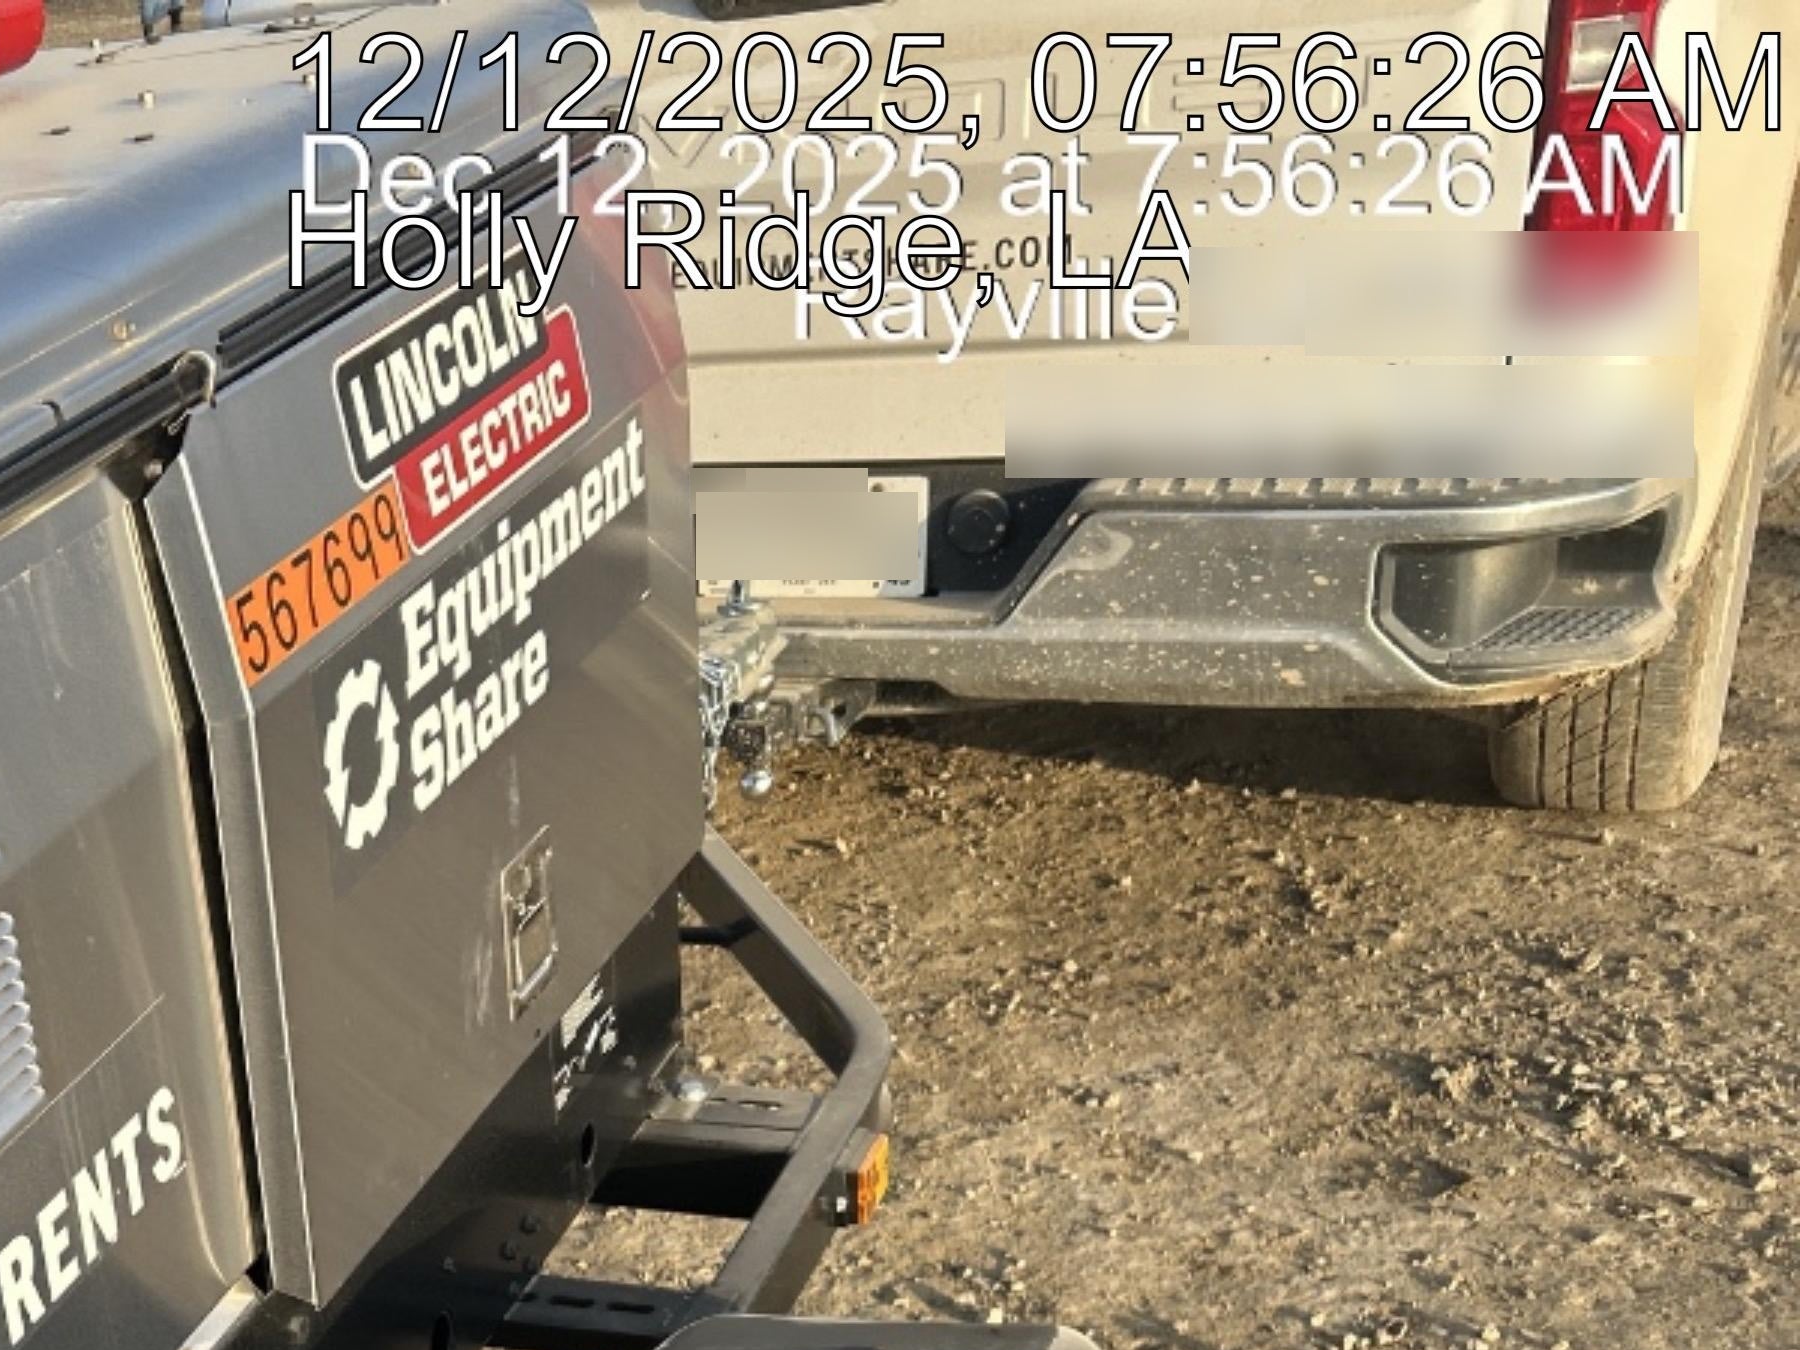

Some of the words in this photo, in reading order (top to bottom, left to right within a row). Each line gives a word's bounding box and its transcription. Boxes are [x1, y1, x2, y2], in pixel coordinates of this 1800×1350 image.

[349, 269, 539, 461] LINCOLN
[420, 361, 572, 519] ELECTRIC
[235, 493, 409, 674] 567699
[399, 417, 647, 701] Equipment
[410, 630, 550, 813] Share
